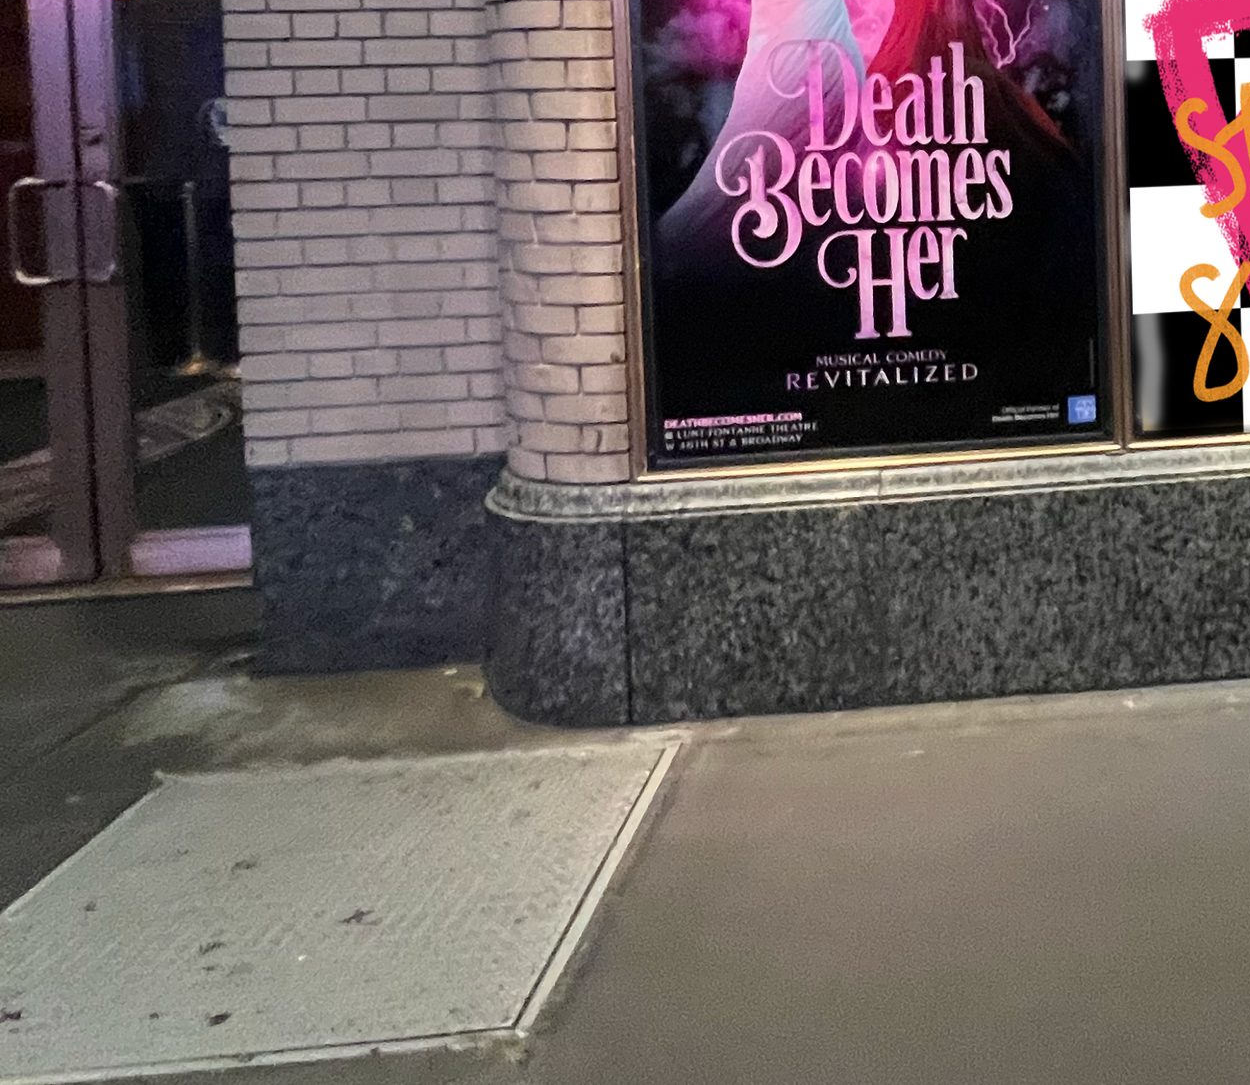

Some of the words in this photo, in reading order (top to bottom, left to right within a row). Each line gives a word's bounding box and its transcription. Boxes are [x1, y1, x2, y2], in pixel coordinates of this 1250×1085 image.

[766, 39, 989, 152] Death
[715, 130, 1014, 269] Becomes
[817, 225, 969, 340] Her
[786, 363, 978, 391] REVITALIZED
[815, 353, 881, 368] MUSICAL
[886, 349, 949, 363] COMEDY
[742, 434, 803, 447] BROADWAY
